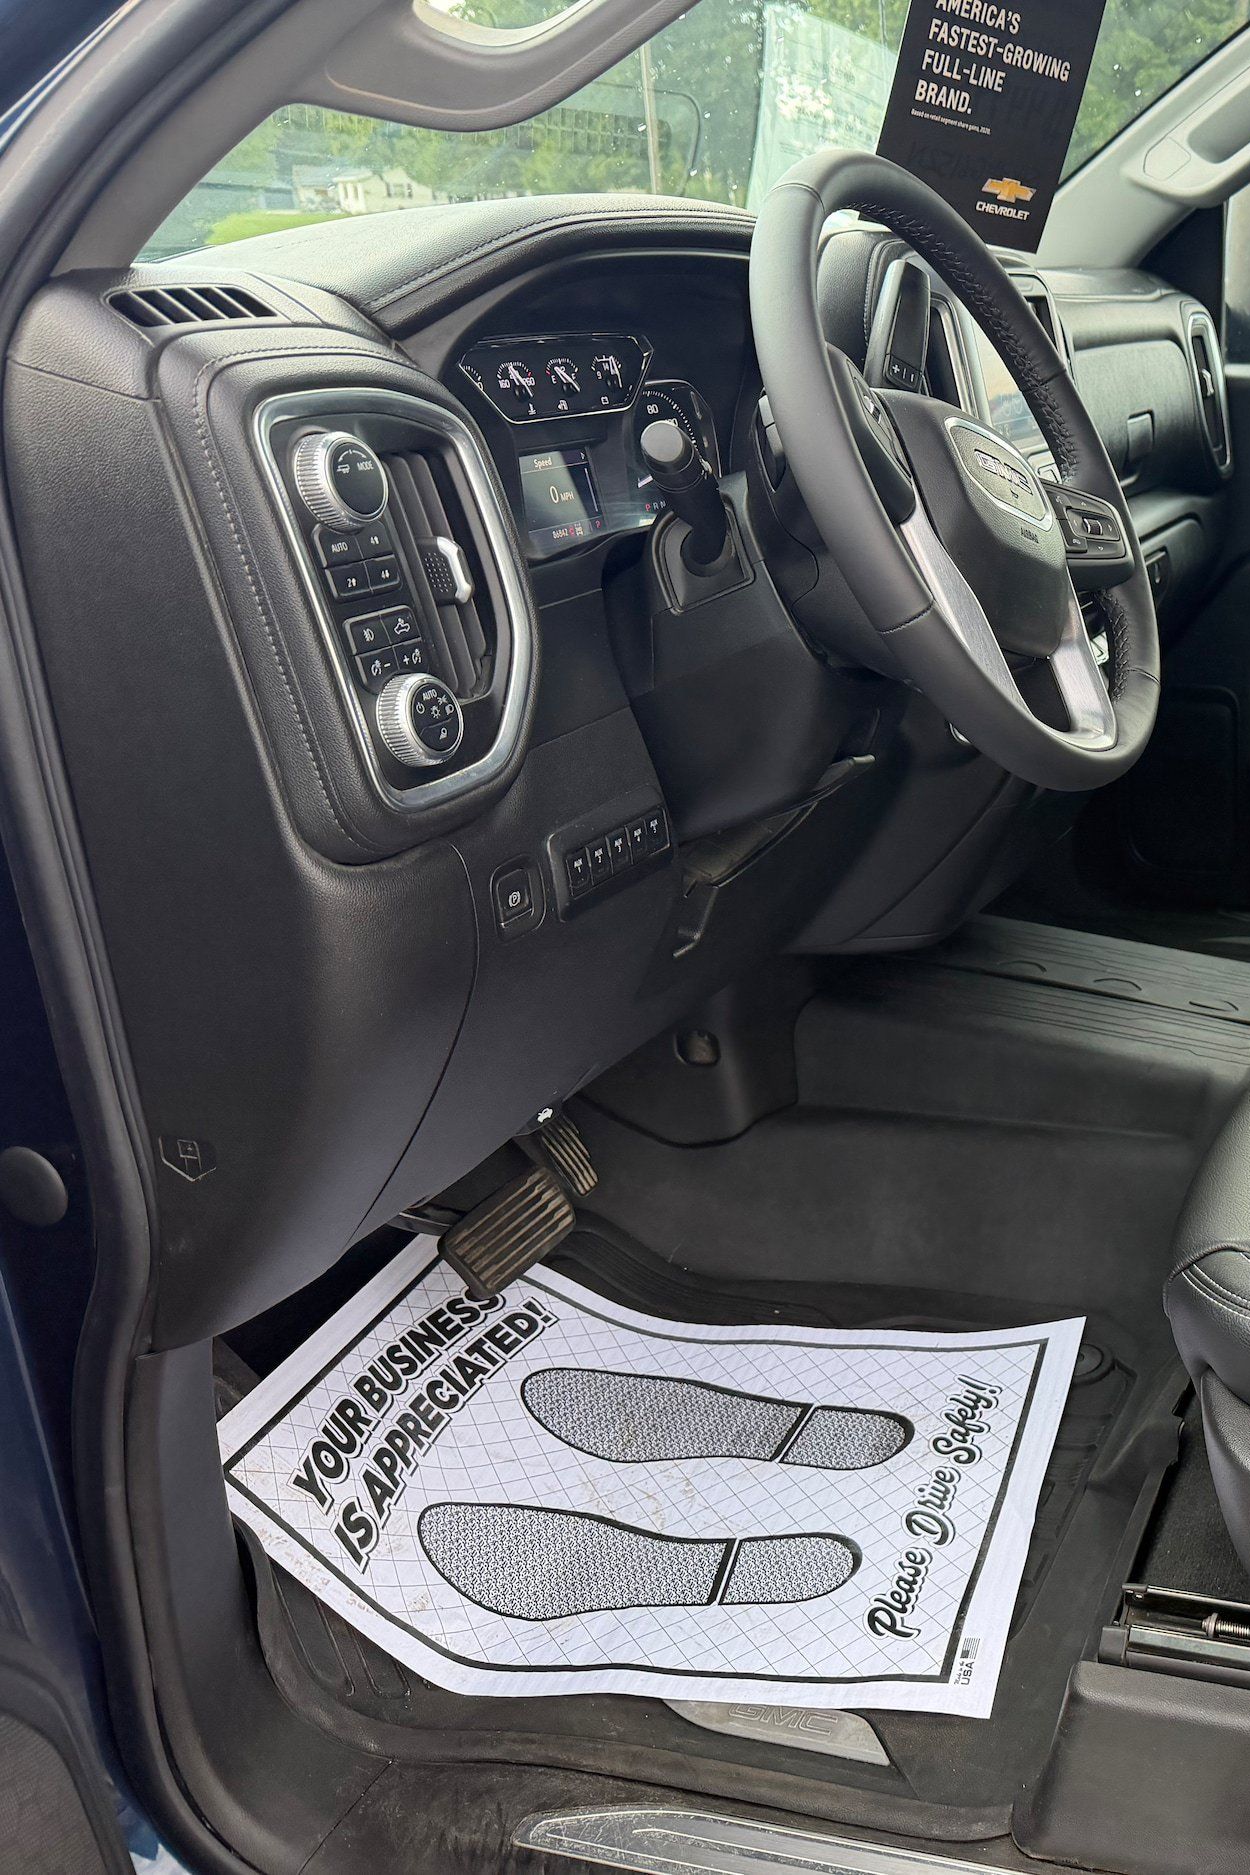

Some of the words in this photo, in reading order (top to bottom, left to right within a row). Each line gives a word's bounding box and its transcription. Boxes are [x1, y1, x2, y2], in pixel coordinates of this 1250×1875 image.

[928, 18, 1072, 82] FASTEST-GROWING
[921, 49, 1006, 92] FULL-LINE
[914, 79, 972, 114] BRAND.
[910, 108, 924, 118] Based
[975, 200, 1030, 221] CHEVROLET
[551, 375, 557, 384] E
[646, 404, 659, 415] 80
[356, 461, 374, 472] MODE
[533, 456, 553, 470] Speed
[549, 485, 559, 504] 0
[560, 491, 575, 502] MPH
[645, 503, 652, 512] P
[331, 541, 349, 553] AUTO
[422, 688, 438, 701] AUTO
[333, 1500, 380, 1570] IS
[361, 1298, 555, 1524] APPRECIATED!
[290, 1397, 376, 1511] YOUR
[866, 1548, 928, 1640] Please
[904, 1467, 956, 1547] Drive
[931, 1374, 1000, 1466] Safely!
[960, 1661, 975, 1686] USA
[727, 1702, 839, 1737] GMC
